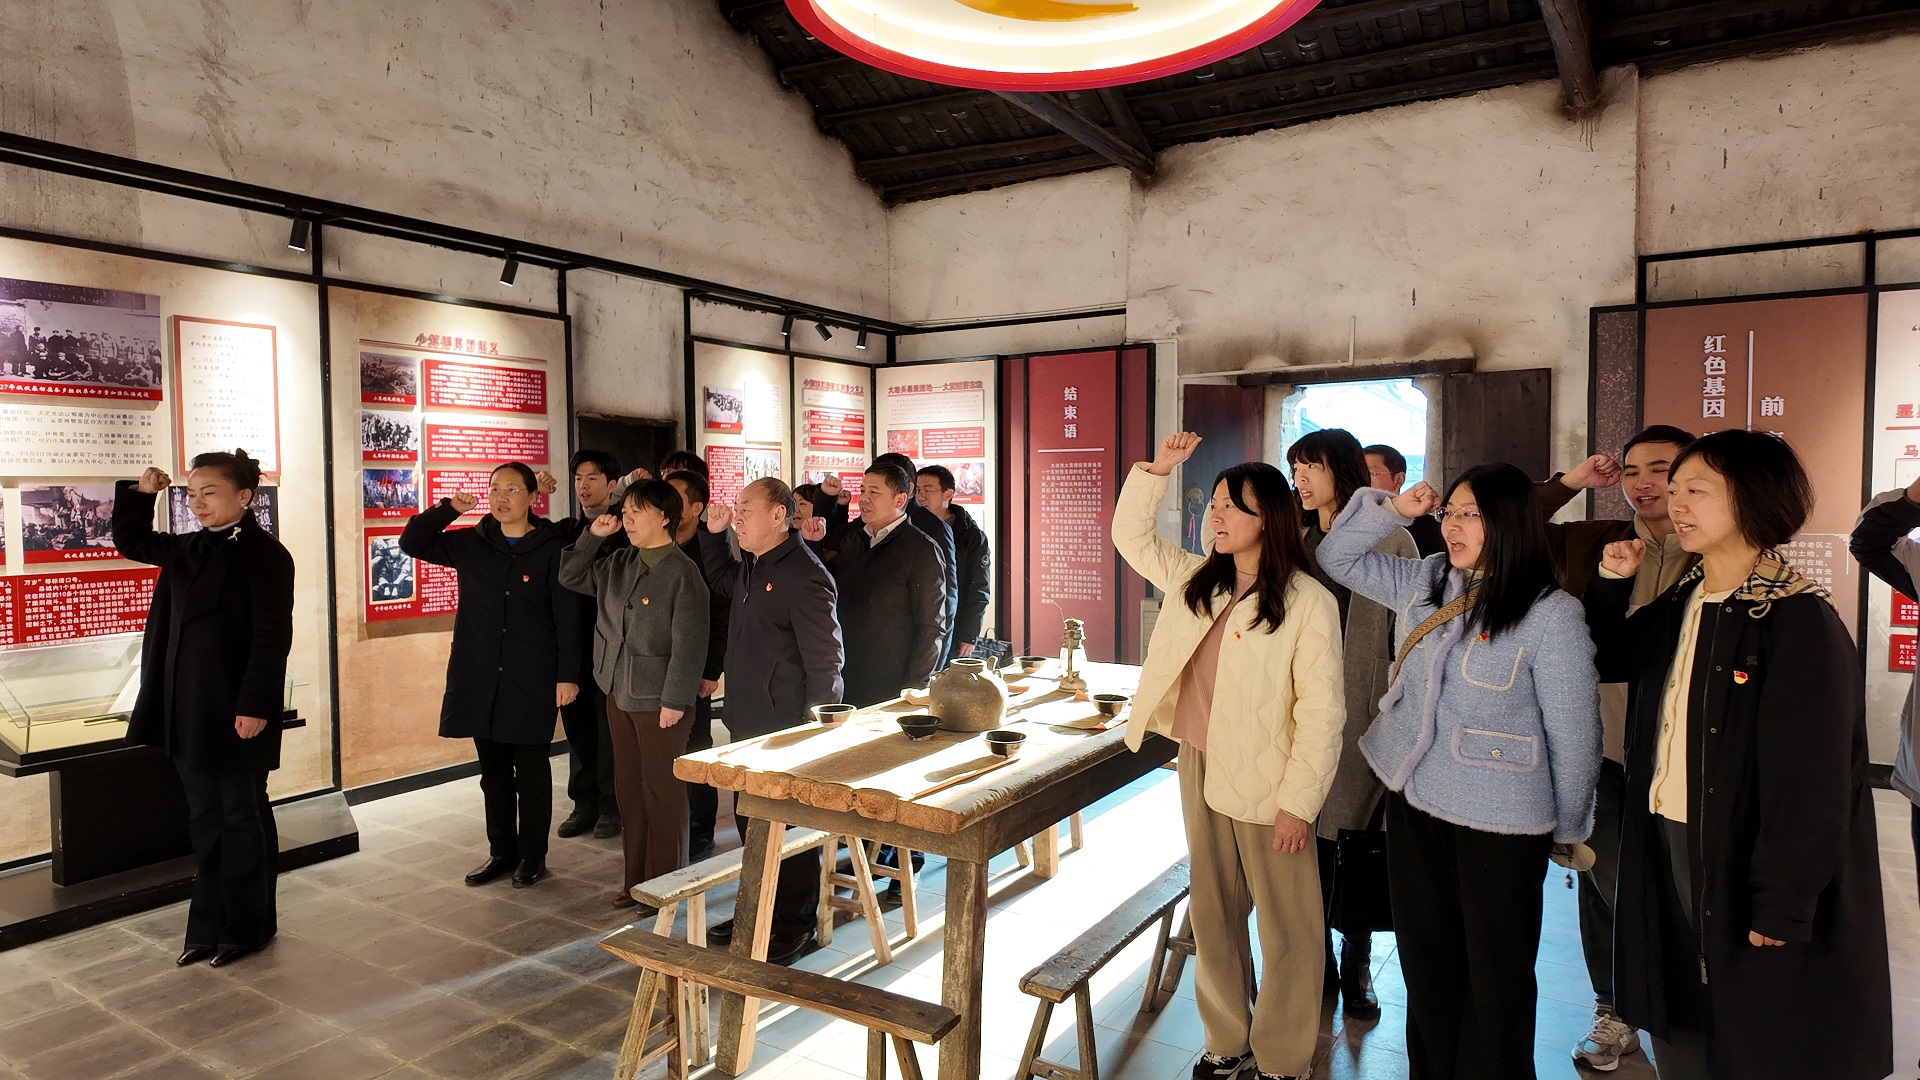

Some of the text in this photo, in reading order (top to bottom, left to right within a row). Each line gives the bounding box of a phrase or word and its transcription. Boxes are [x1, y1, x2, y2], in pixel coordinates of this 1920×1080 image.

[1063, 386, 1079, 439] 结束语
[1703, 335, 1727, 437] 红色基因
